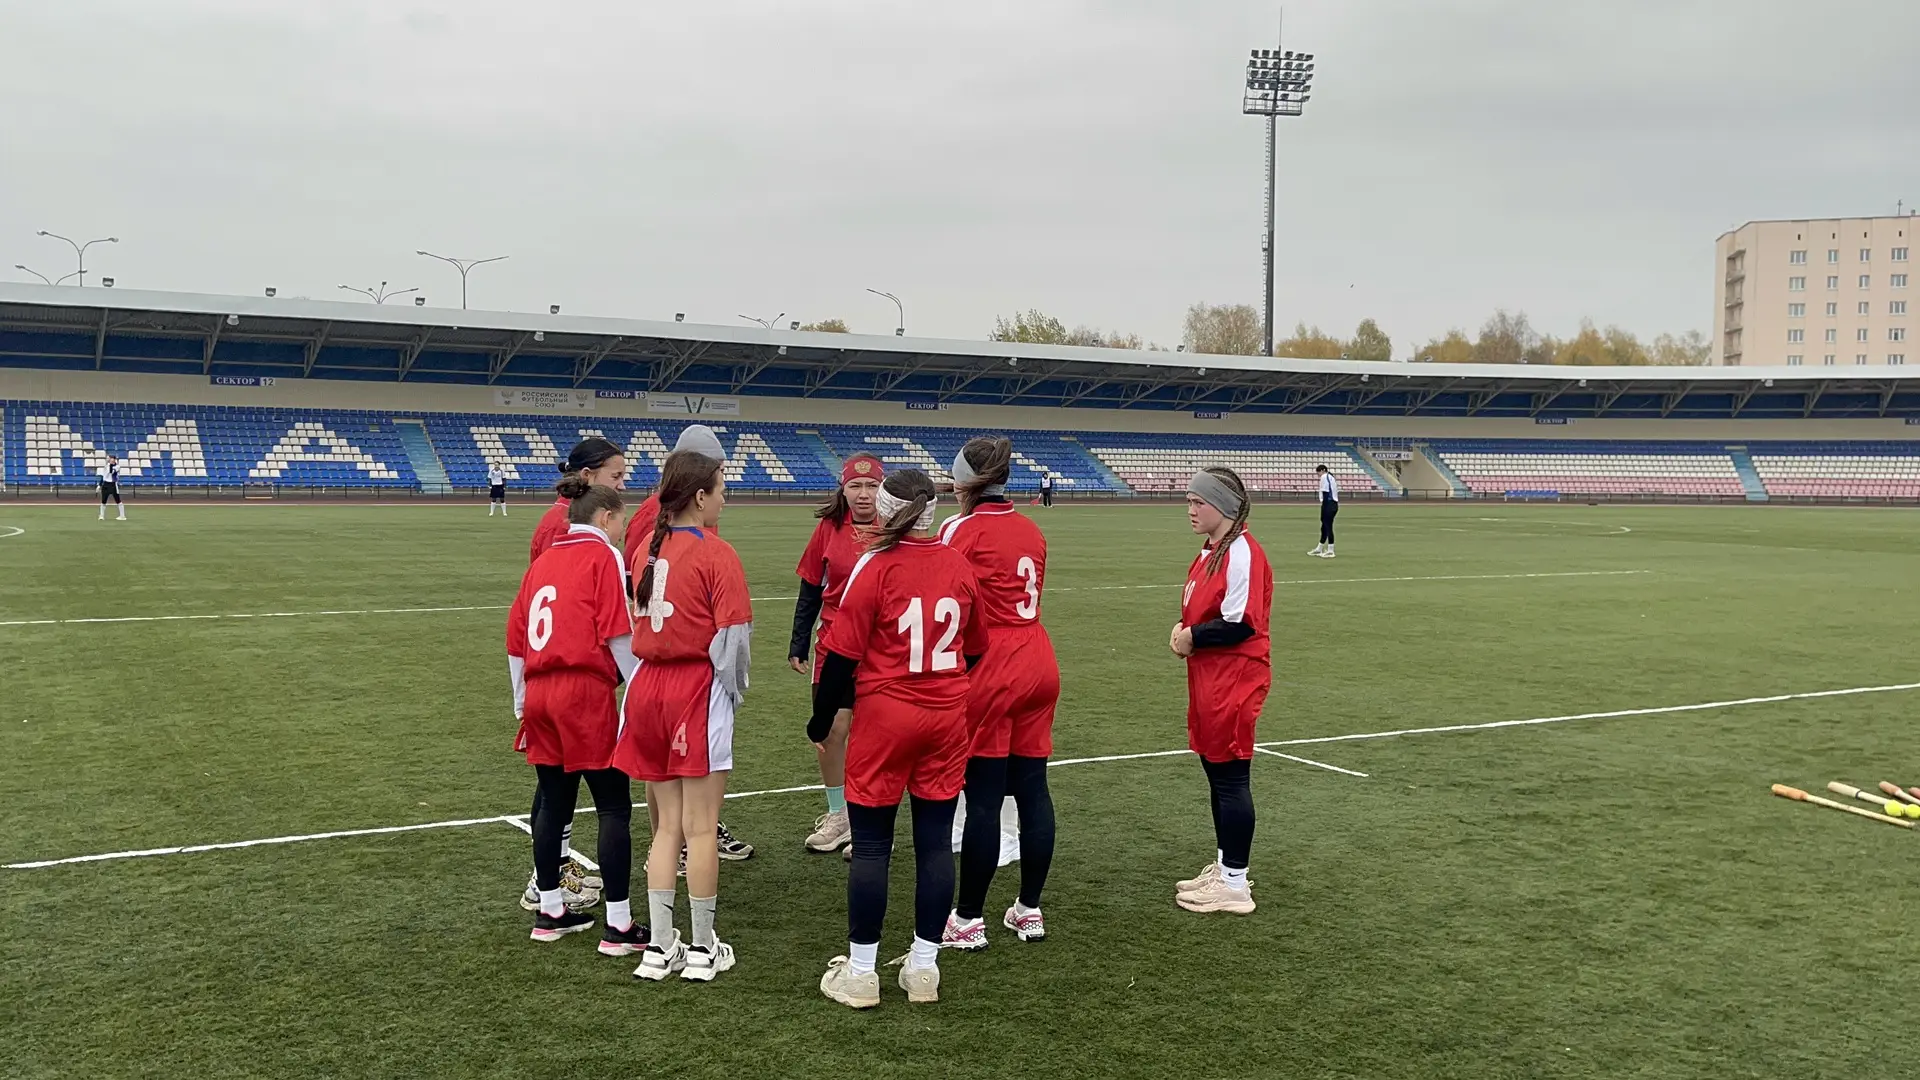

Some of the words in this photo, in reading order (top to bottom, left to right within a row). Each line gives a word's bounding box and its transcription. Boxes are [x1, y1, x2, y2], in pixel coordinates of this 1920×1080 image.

[216, 376, 255, 385] СЕКТОР
[263, 378, 274, 386] 12
[636, 391, 646, 399] 13
[527, 585, 556, 651] 6
[634, 559, 674, 633] 4
[1016, 556, 1039, 620] 3
[897, 596, 961, 673] 12
[671, 722, 688, 757] 4
